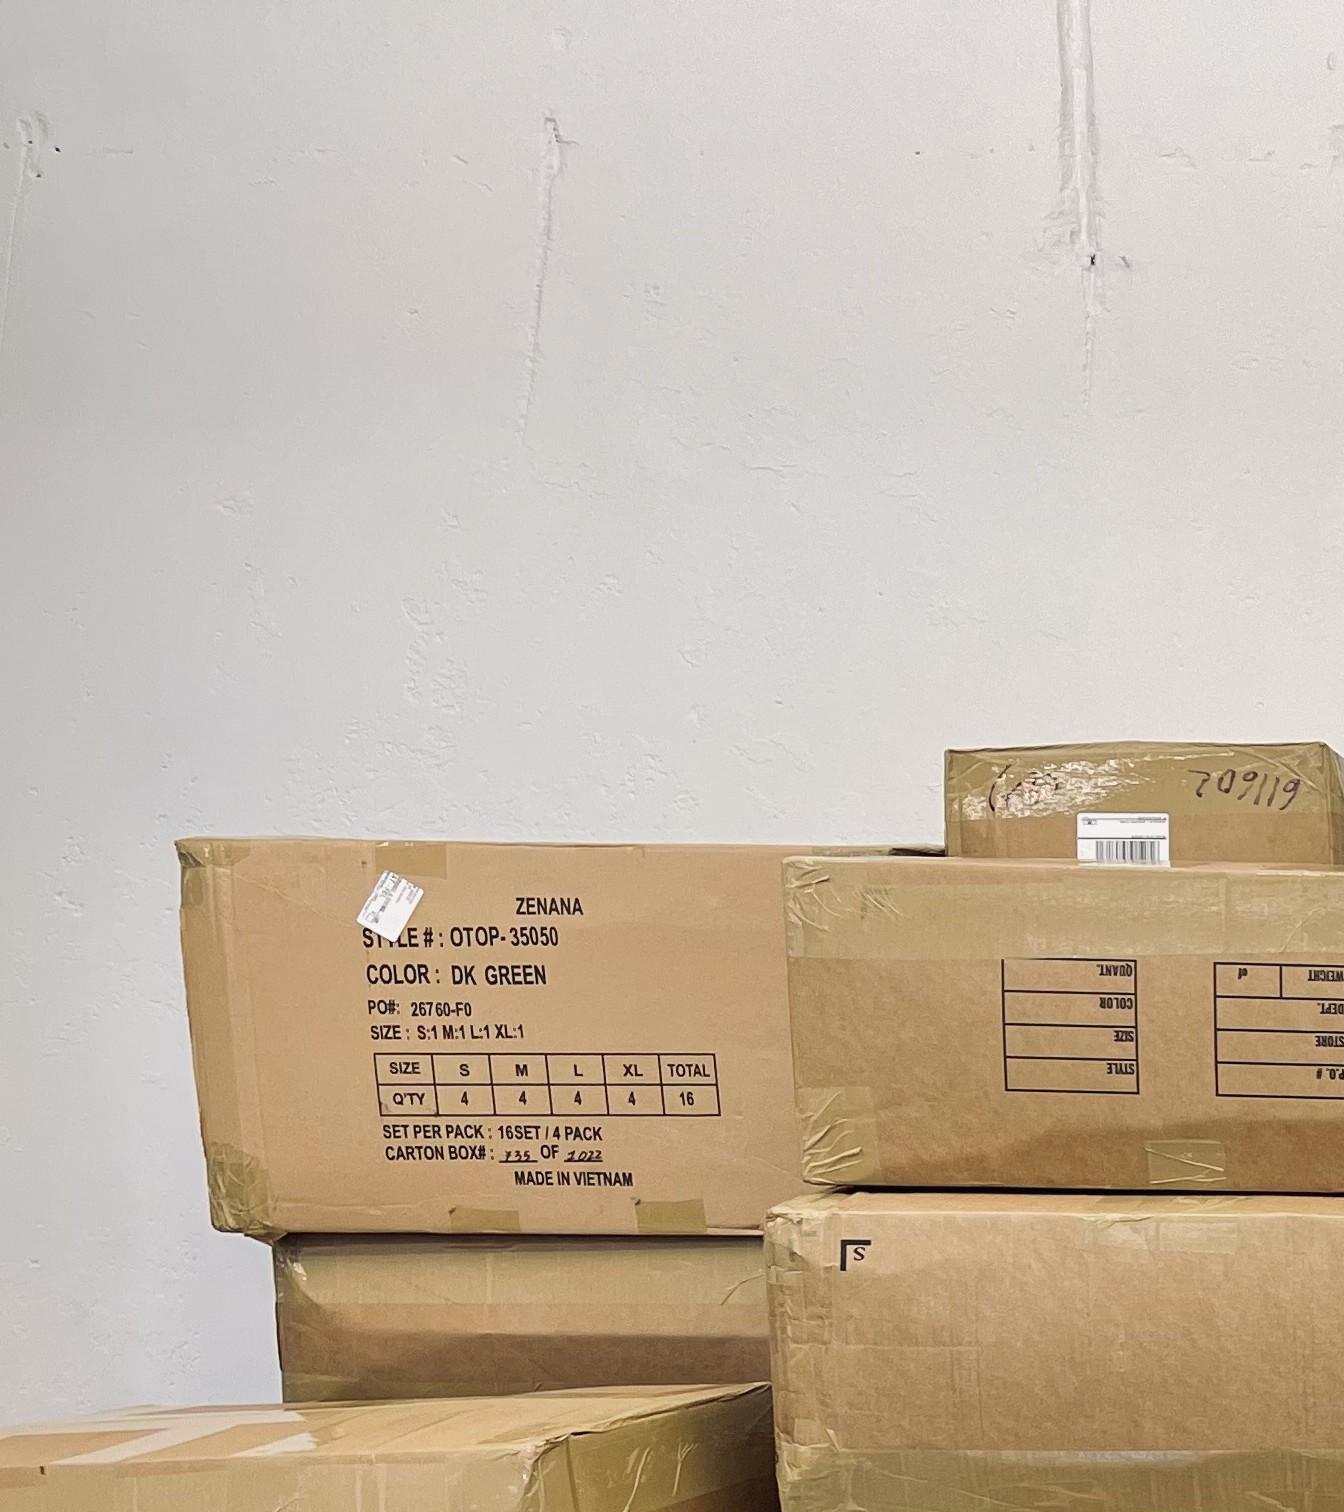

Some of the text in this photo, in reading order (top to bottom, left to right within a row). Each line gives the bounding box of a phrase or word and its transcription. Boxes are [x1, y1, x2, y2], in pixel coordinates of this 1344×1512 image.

[515, 897, 584, 916] ZENANA
[362, 927, 419, 948] SLE
[451, 965, 477, 986] DK
[485, 964, 547, 986] GREEN
[1098, 964, 1133, 977] QUANT.
[1307, 969, 1344, 982] WEIGHT
[1099, 997, 1133, 1009] COLOR
[1317, 1002, 1344, 1015] DEPT.
[417, 1025, 438, 1041] S:1
[442, 1025, 467, 1041] M:1
[470, 1025, 491, 1041] L:1
[495, 1025, 524, 1041] XL:1
[1113, 1030, 1134, 1042] SIZE
[1315, 1035, 1344, 1047] STORE
[389, 1062, 711, 1078] SIZE S M L XL TOTAL
[1106, 1063, 1135, 1075] STYLE
[392, 1091, 695, 1107] Q'TY 4 4 4 4 16
[383, 1124, 410, 1140] SET
[412, 1125, 443, 1140] PER
[552, 1126, 561, 1141] 4
[565, 1126, 602, 1142] PACK
[385, 1146, 445, 1161] CARTON
[540, 1145, 559, 1161] OF
[514, 1171, 633, 1188] MADE IN VIETNAM
